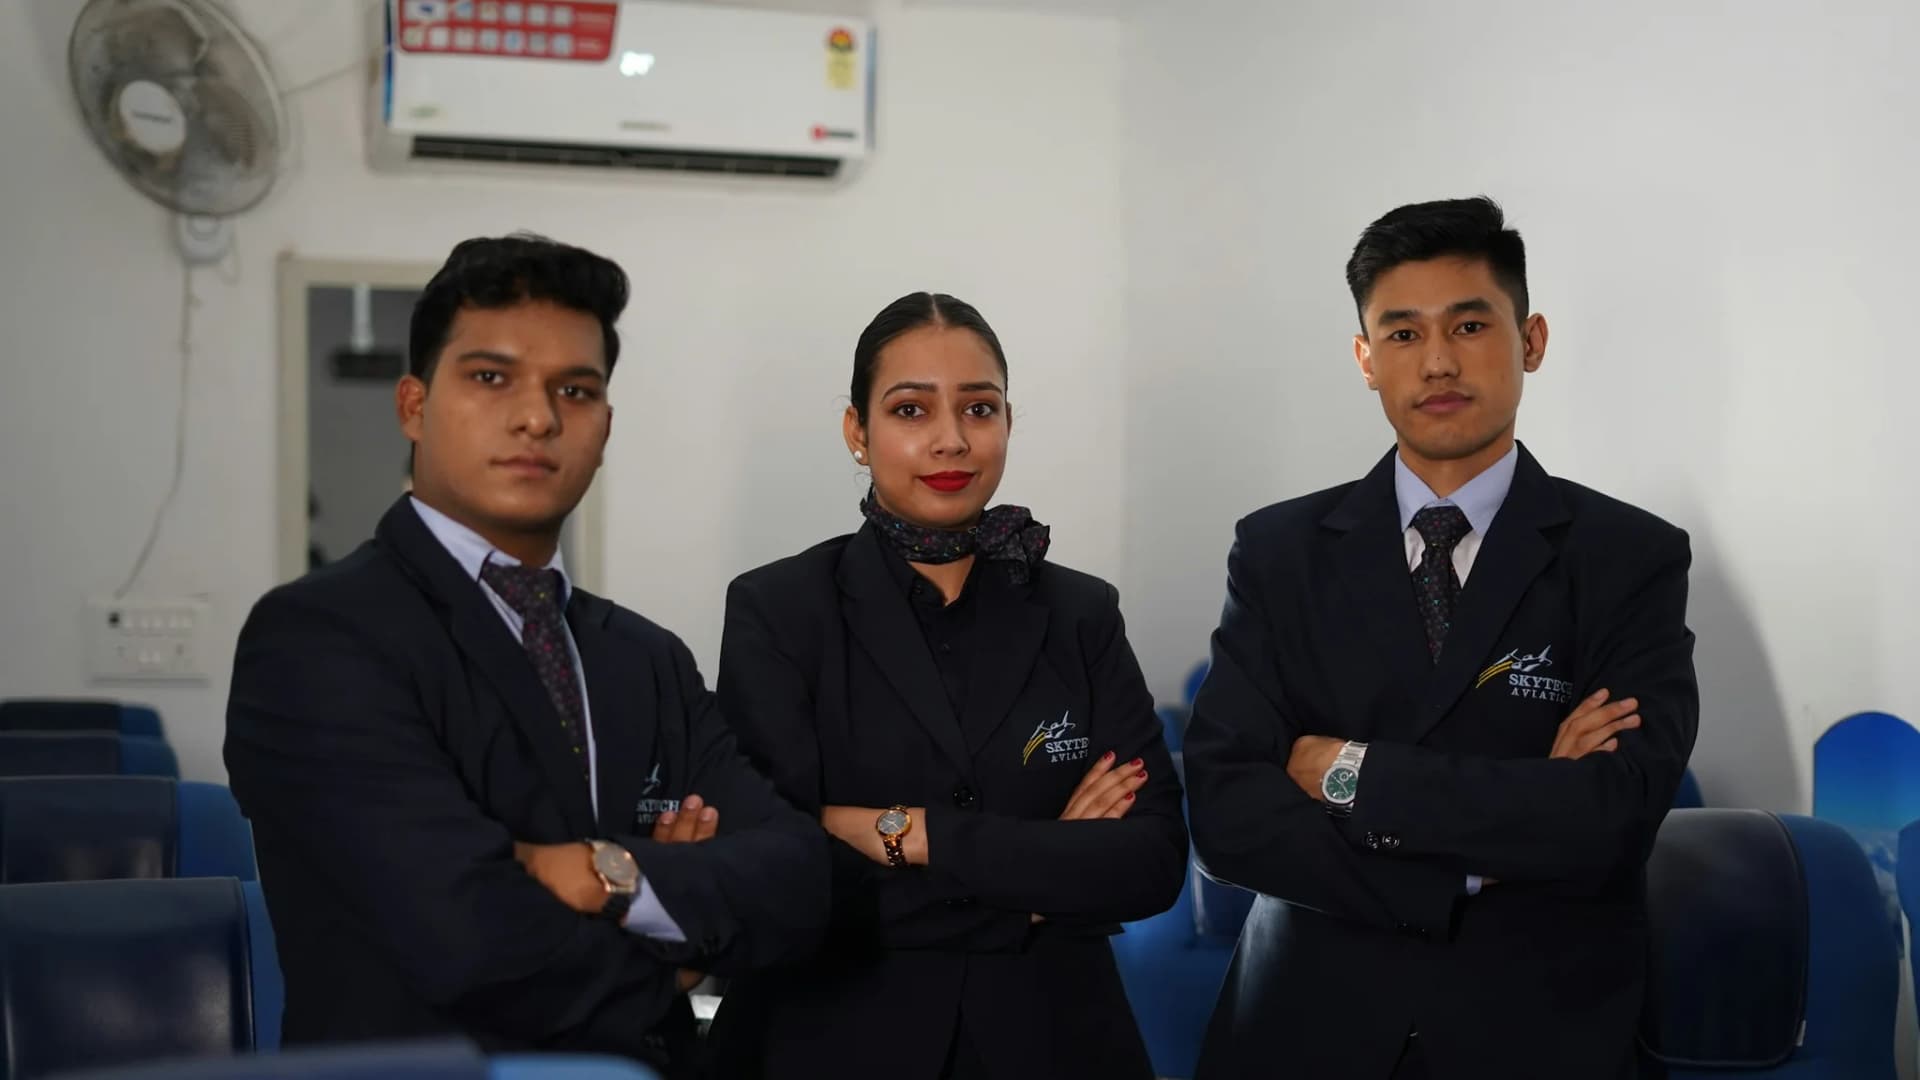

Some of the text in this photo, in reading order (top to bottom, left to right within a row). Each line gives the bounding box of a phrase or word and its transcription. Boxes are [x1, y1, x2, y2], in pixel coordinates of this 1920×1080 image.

[1510, 687, 1572, 704] AVIATIO
[1045, 737, 1089, 754] SKYTE
[1050, 749, 1088, 763] AVIATI
